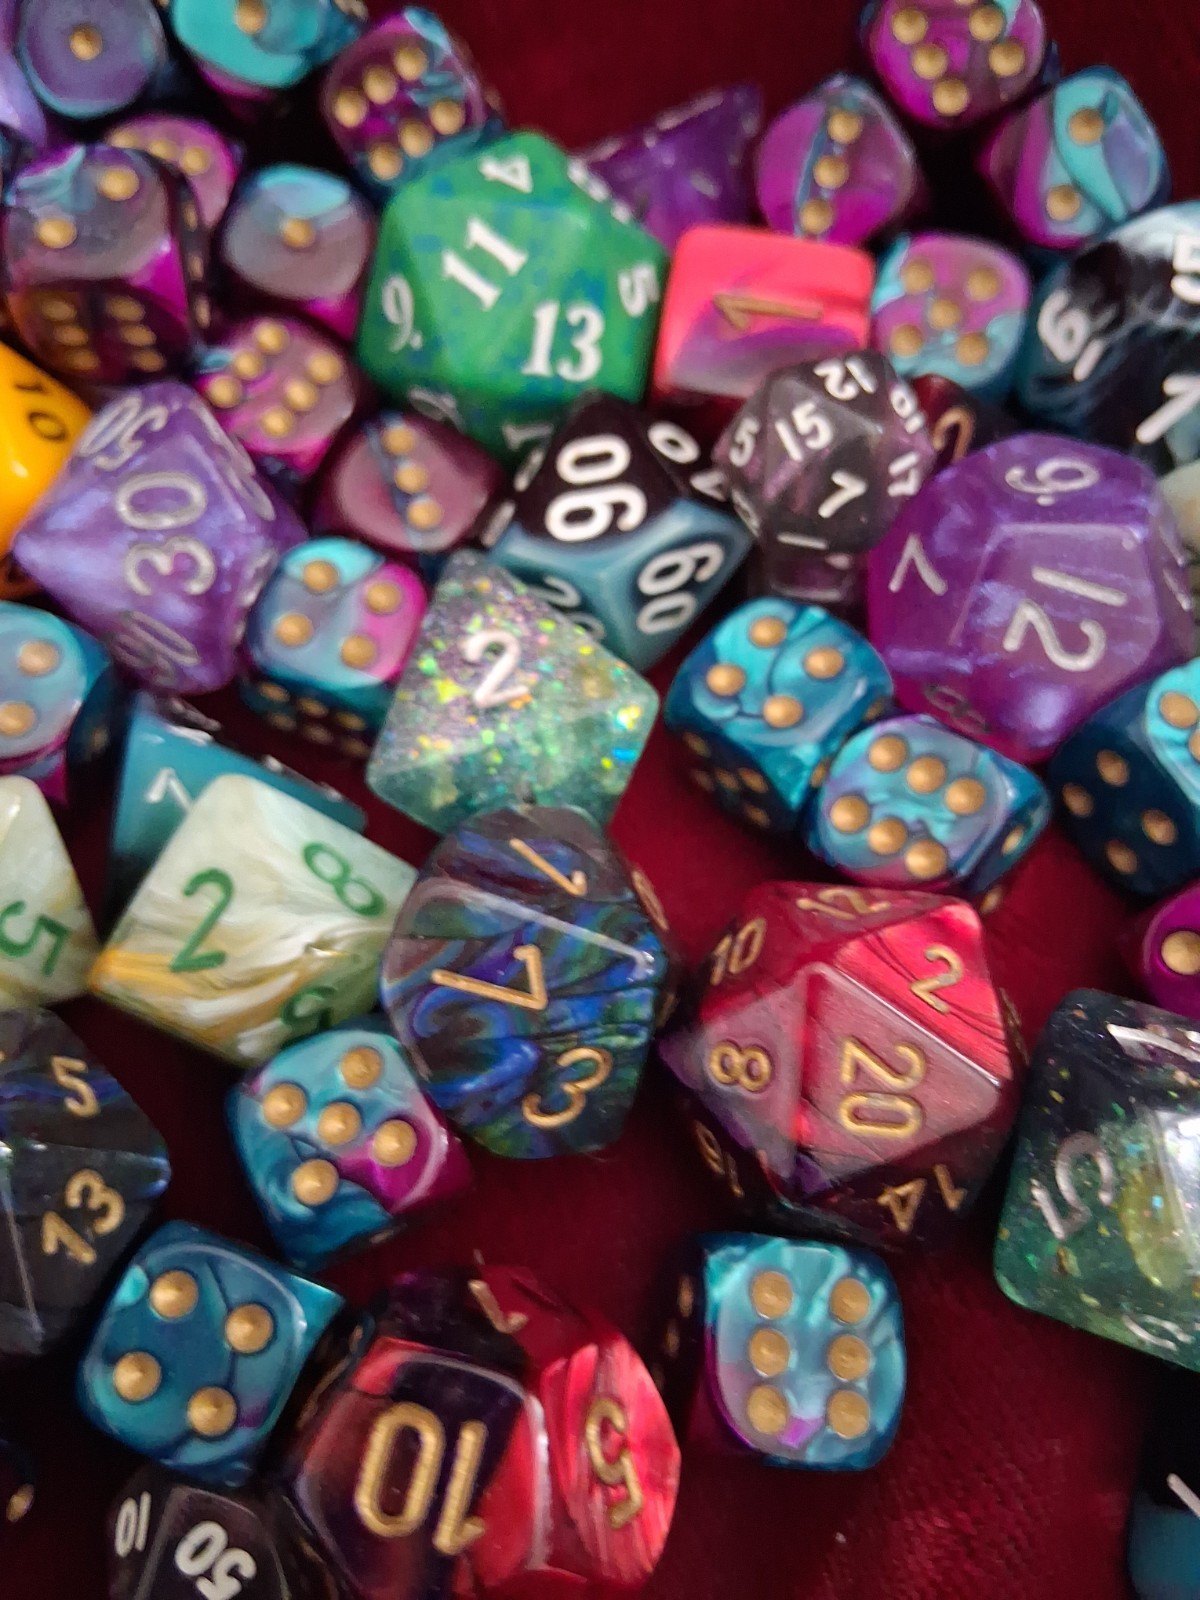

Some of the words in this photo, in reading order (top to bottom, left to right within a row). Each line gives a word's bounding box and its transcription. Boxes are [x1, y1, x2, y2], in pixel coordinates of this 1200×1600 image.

[440, 213, 530, 311] 11
[519, 299, 606, 382] 13
[728, 416, 761, 467] 5
[774, 402, 834, 462] 15
[116, 471, 217, 597] 30
[1003, 564, 1128, 672] 12
[463, 629, 533, 708] 2
[170, 868, 235, 973] 2
[303, 841, 387, 918] 8
[710, 918, 768, 986] 10
[910, 944, 963, 1014] 2
[51, 1055, 99, 1118] 5
[522, 1046, 613, 1129] 3
[709, 1040, 775, 1092] 8
[839, 1035, 926, 1138] 20
[40, 1168, 125, 1265] 13
[353, 1402, 489, 1556] 10
[174, 1519, 257, 1600] 50
